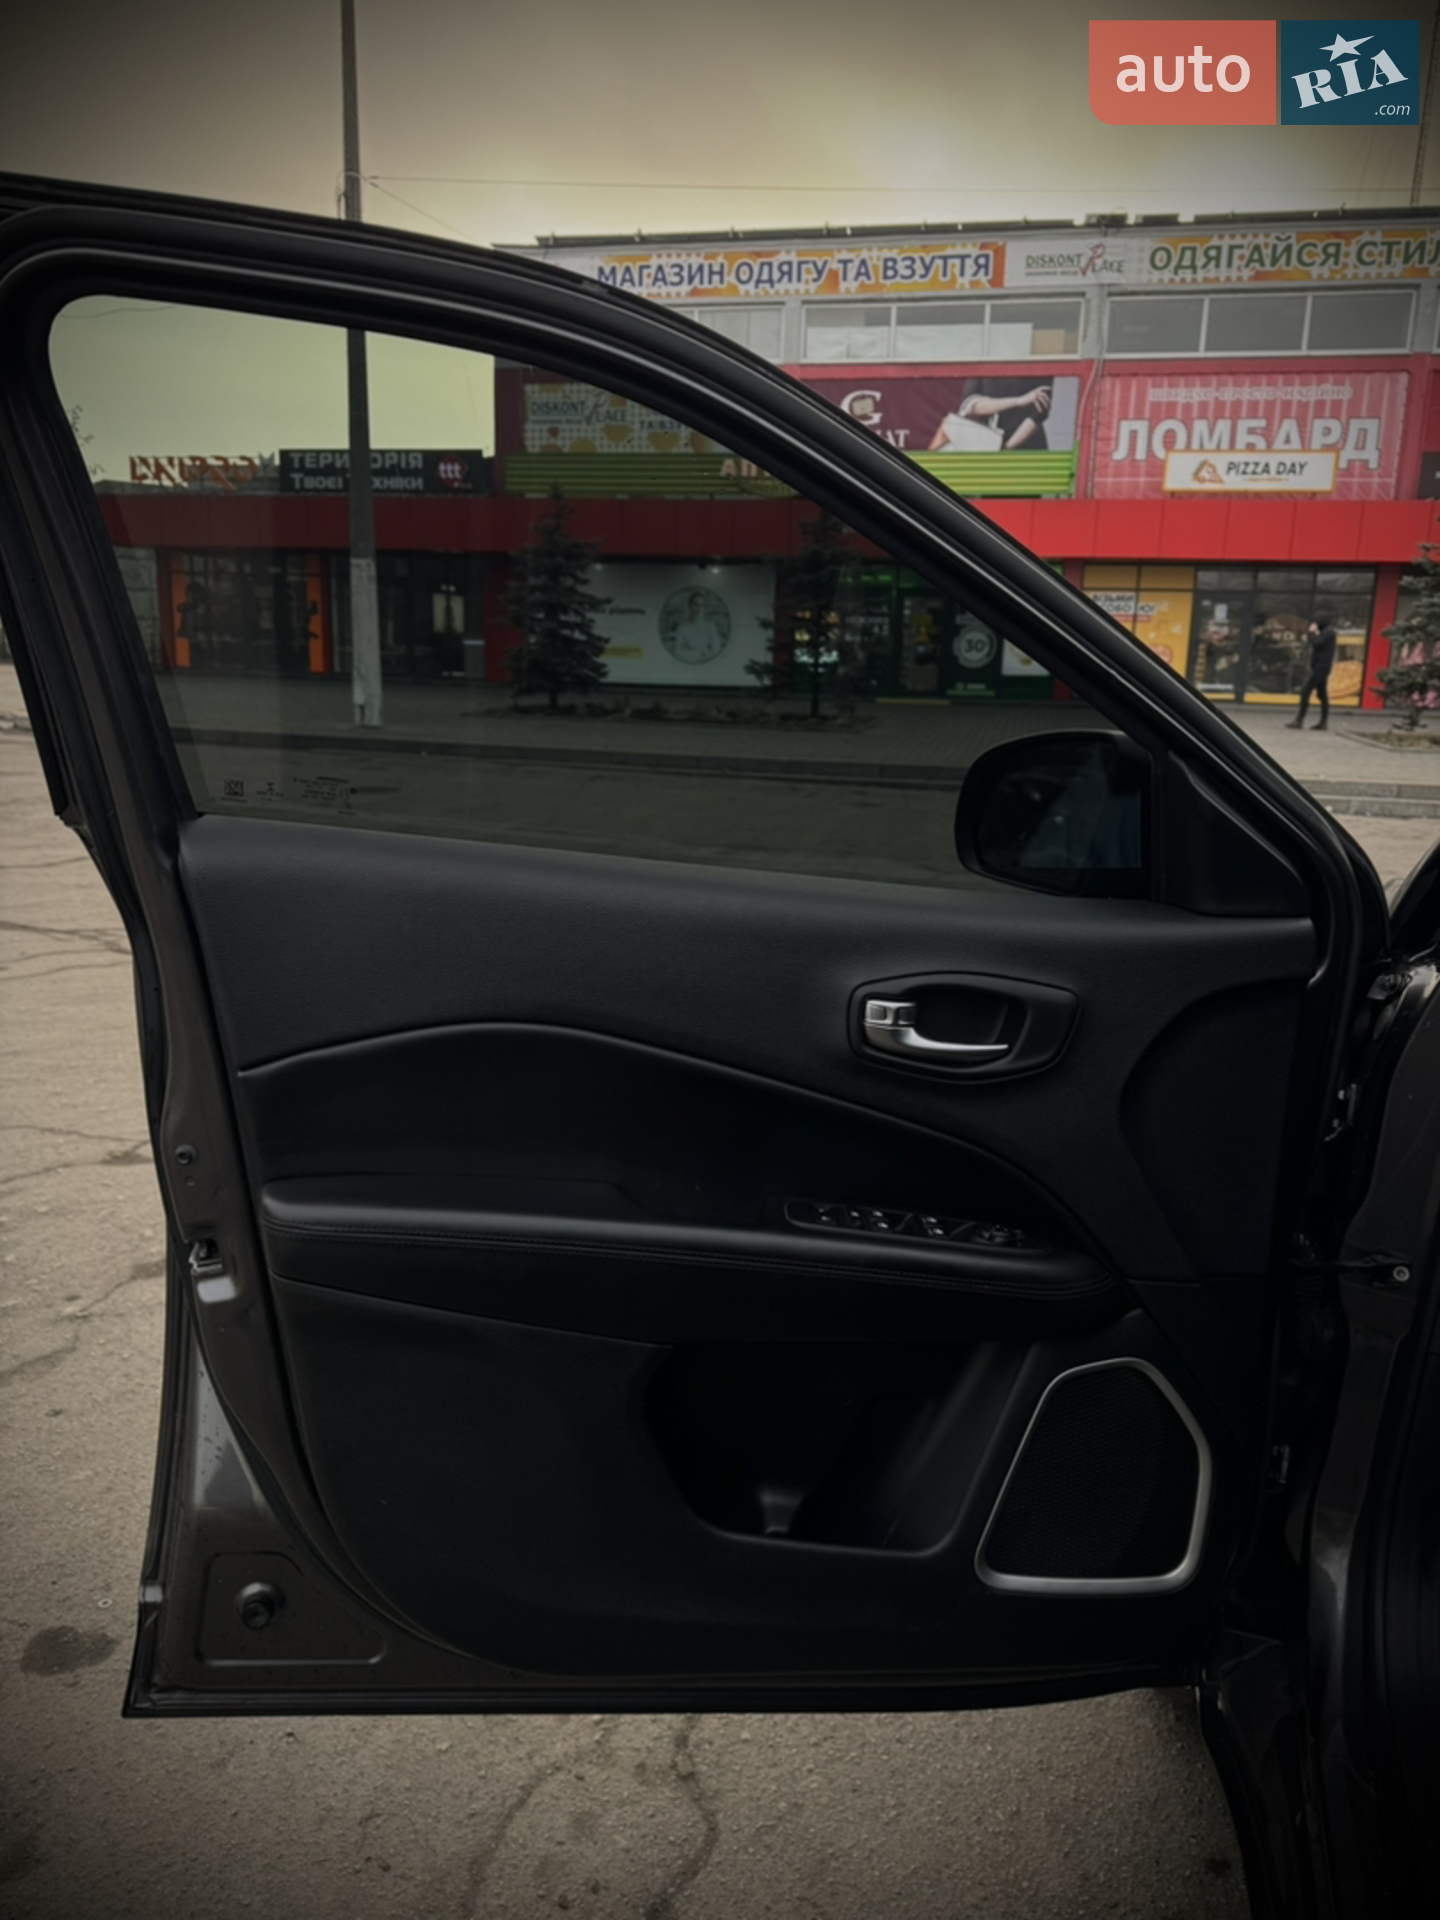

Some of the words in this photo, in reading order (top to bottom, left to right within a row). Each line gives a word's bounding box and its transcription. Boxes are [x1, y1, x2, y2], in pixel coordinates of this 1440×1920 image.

[1025, 253, 1082, 268] DISKONT
[1148, 235, 1341, 275] ОДЯГАЙСЯ
[597, 262, 725, 288] МАГАЗИН
[734, 258, 829, 289] ОДЯГУ
[837, 258, 872, 282] ТА
[881, 252, 991, 281] ВЗУТТЯ
[531, 400, 586, 416] DISKONT
[1111, 417, 1381, 470] ЛОМБАРД
[290, 452, 423, 470] ТЕРИОРІЯ
[1226, 461, 1271, 476] PIZZA
[1276, 461, 1309, 476] DAY
[438, 462, 461, 479] ttt
[964, 639, 986, 653] 30
